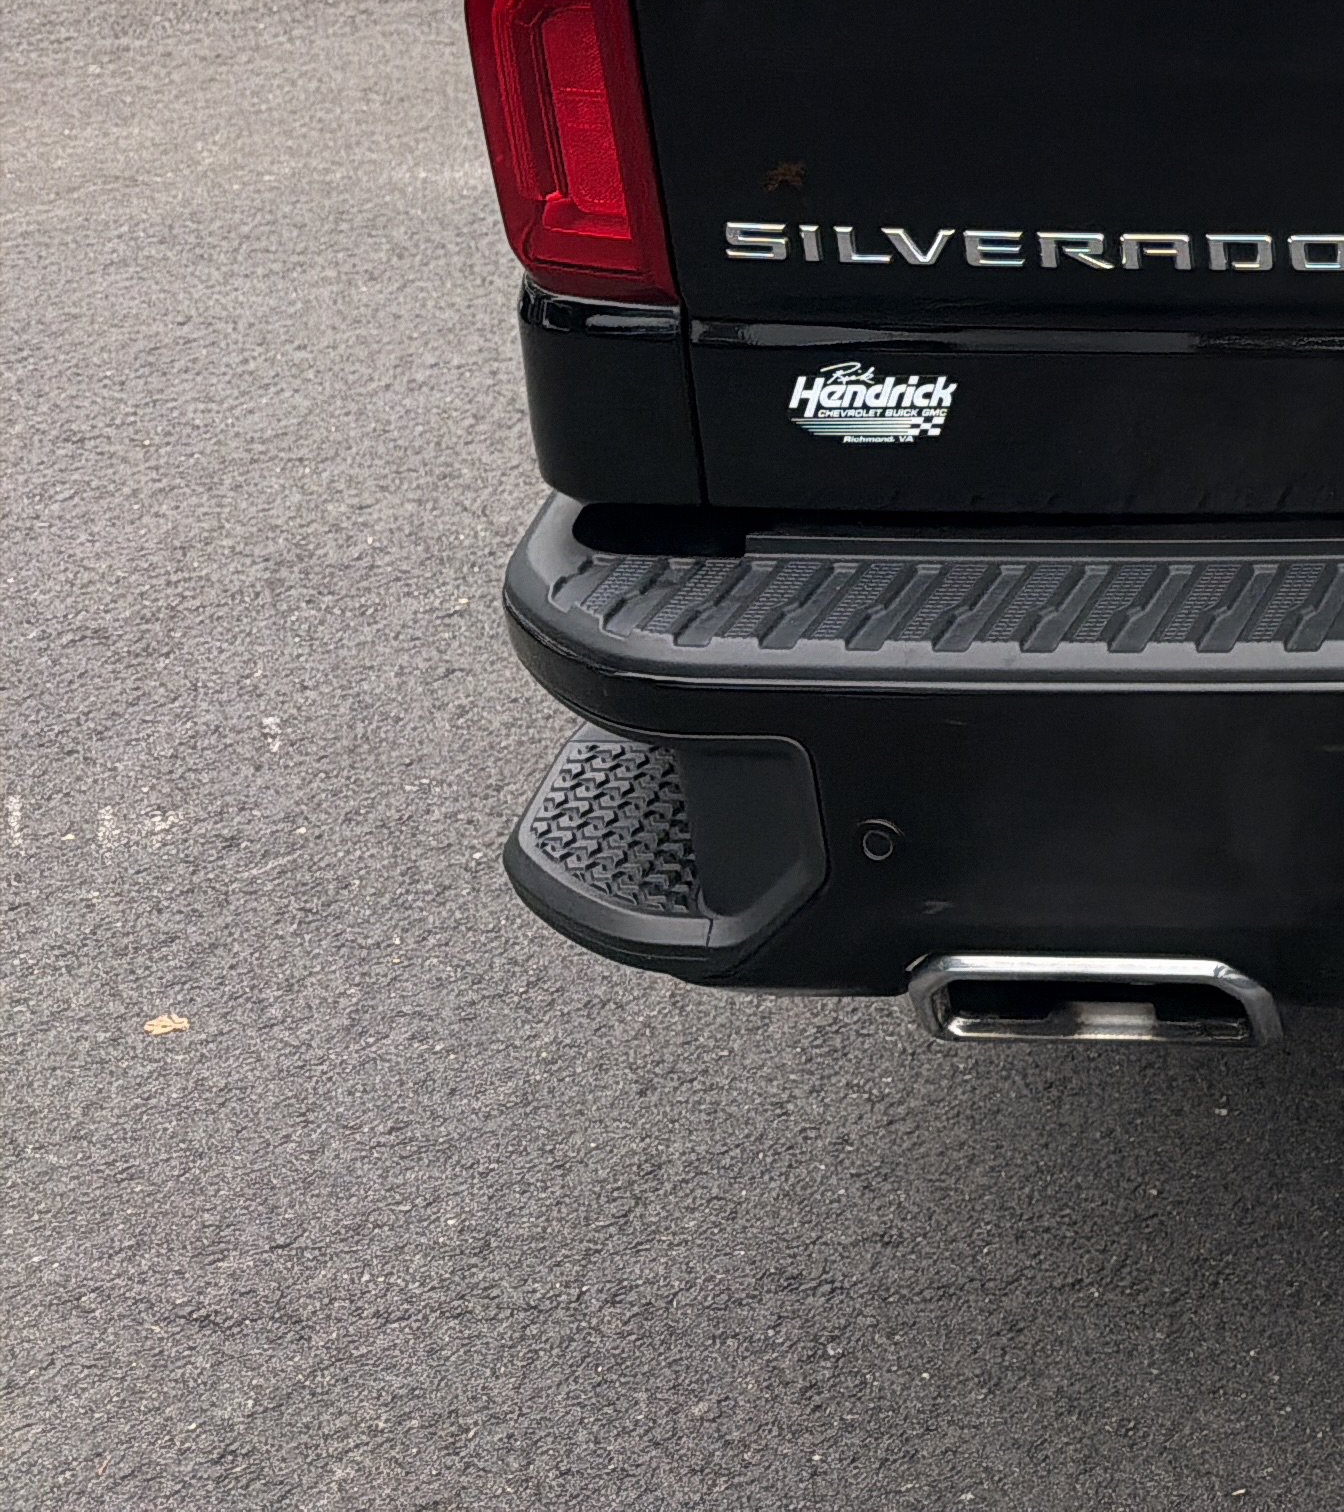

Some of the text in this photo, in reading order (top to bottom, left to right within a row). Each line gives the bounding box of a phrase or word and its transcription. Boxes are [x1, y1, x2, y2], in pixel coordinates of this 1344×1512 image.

[788, 375, 958, 418] Hendrick
[817, 409, 948, 418] CHEVROLET BUICK GMC
[899, 435, 914, 443] VA
